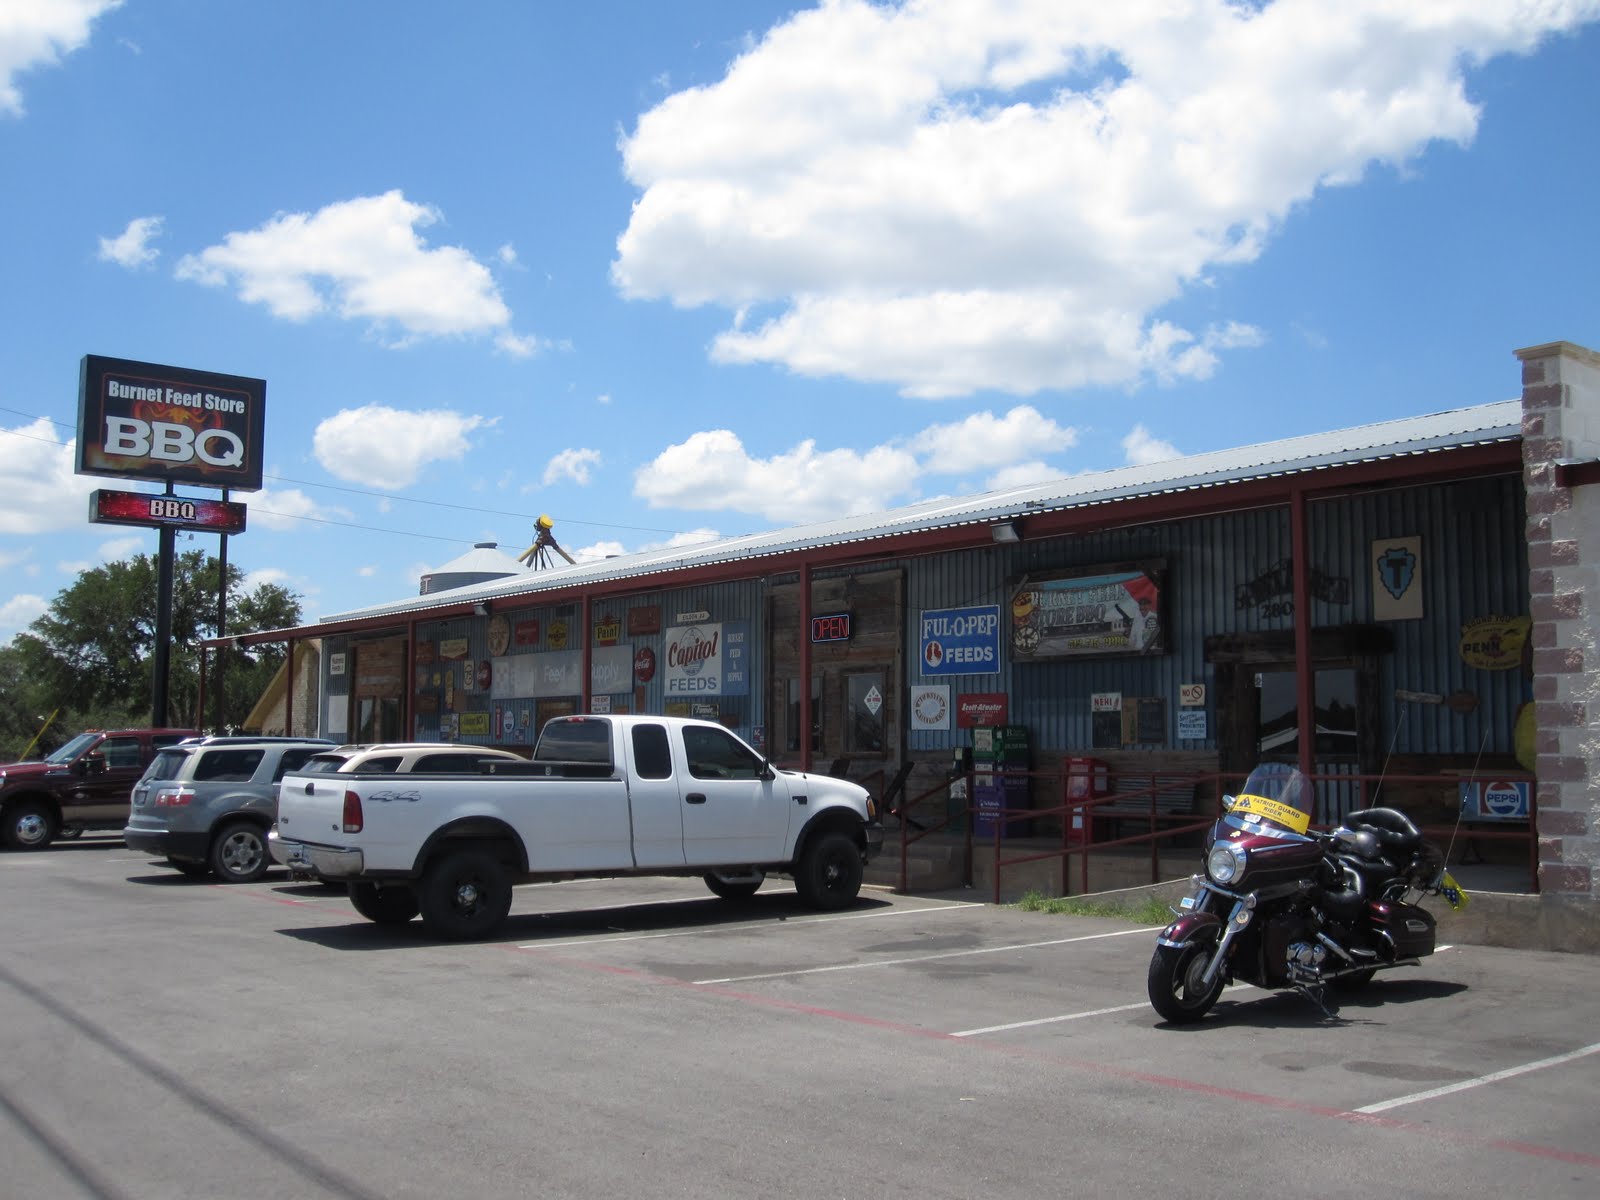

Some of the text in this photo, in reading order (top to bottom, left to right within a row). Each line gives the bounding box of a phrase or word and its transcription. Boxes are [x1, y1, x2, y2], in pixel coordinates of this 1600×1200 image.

[108, 380, 245, 414] Burnet Feed Store
[104, 415, 244, 467] BBQ
[150, 499, 196, 520] BBQ
[597, 626, 617, 639] Paint
[813, 617, 848, 640] OPEN
[668, 631, 719, 668] Capitol
[946, 646, 993, 663] FEEDS
[591, 660, 619, 683] upply
[669, 678, 717, 692] FEEDS
[1182, 689, 1190, 697] NO
[1094, 698, 1112, 706] NEHI
[1487, 793, 1519, 803] PEPSI
[1253, 798, 1277, 808] PATRIOT
[1278, 805, 1301, 819] GUARD
[1263, 807, 1283, 817] RIDER
